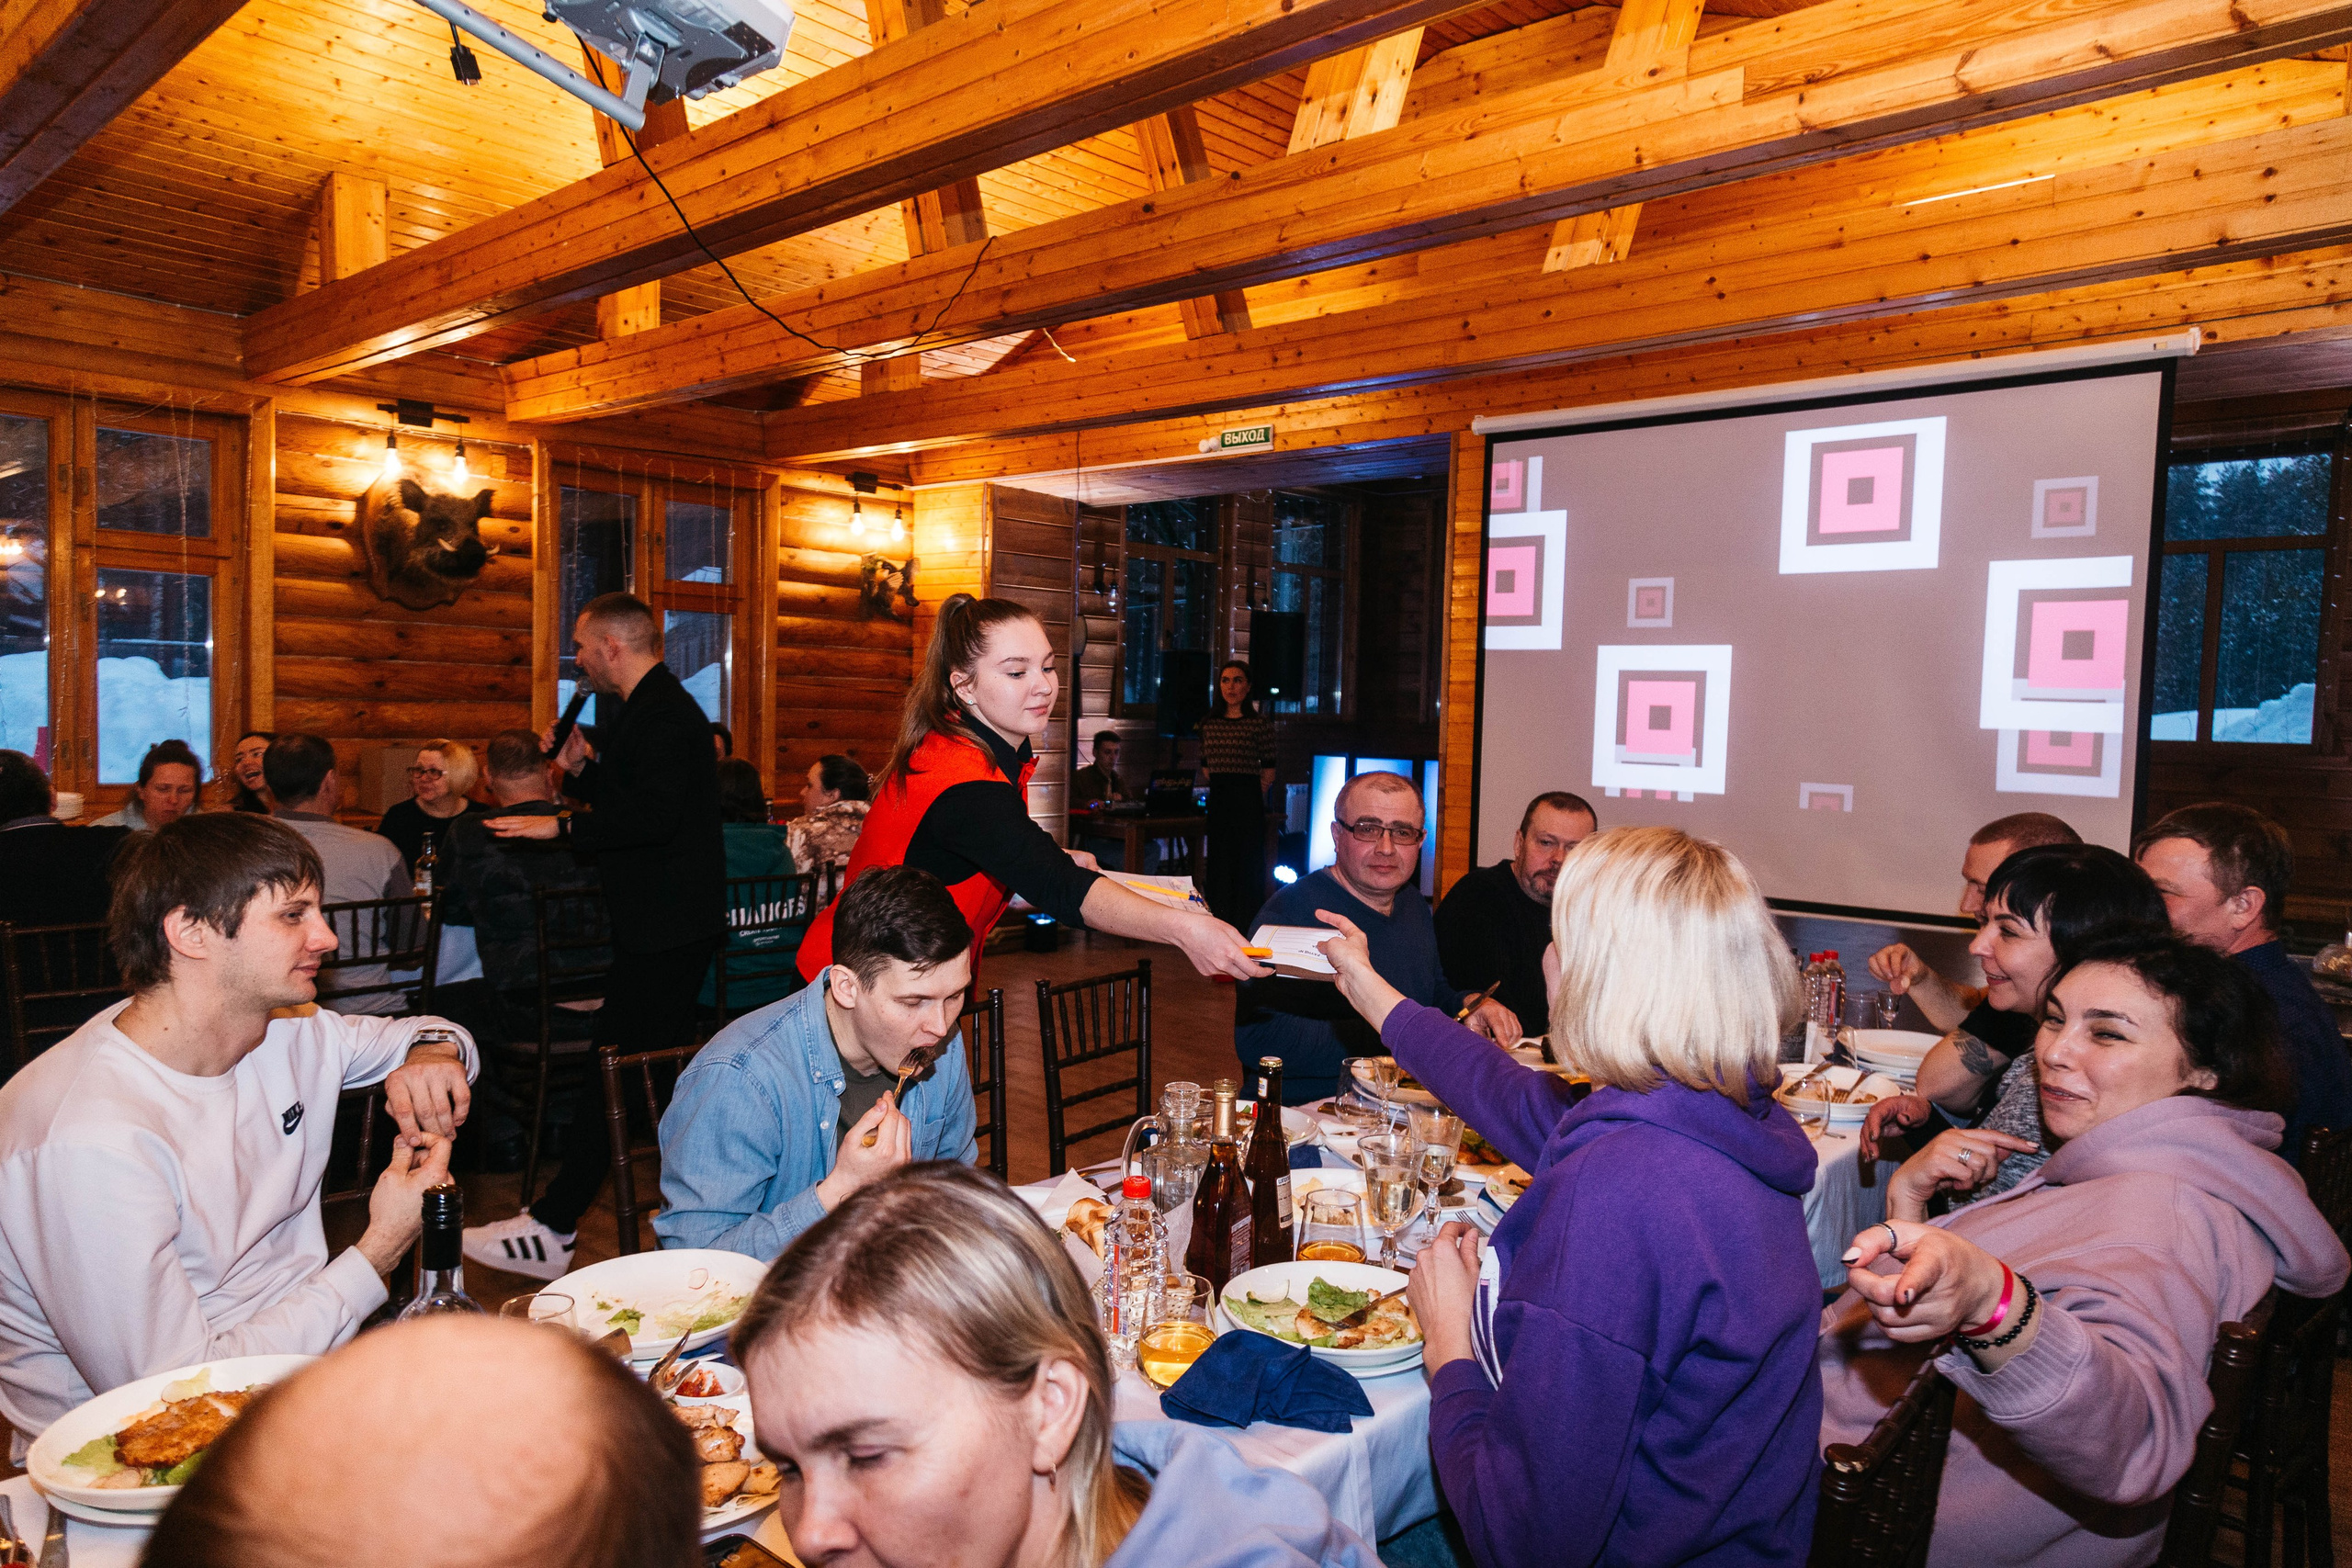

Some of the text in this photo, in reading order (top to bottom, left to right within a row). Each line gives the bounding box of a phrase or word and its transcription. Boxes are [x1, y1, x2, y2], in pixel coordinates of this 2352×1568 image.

[1224, 429, 1265, 446] ВЫХОД
[725, 895, 806, 926] HANGES
[281, 1100, 304, 1124] NIKE
